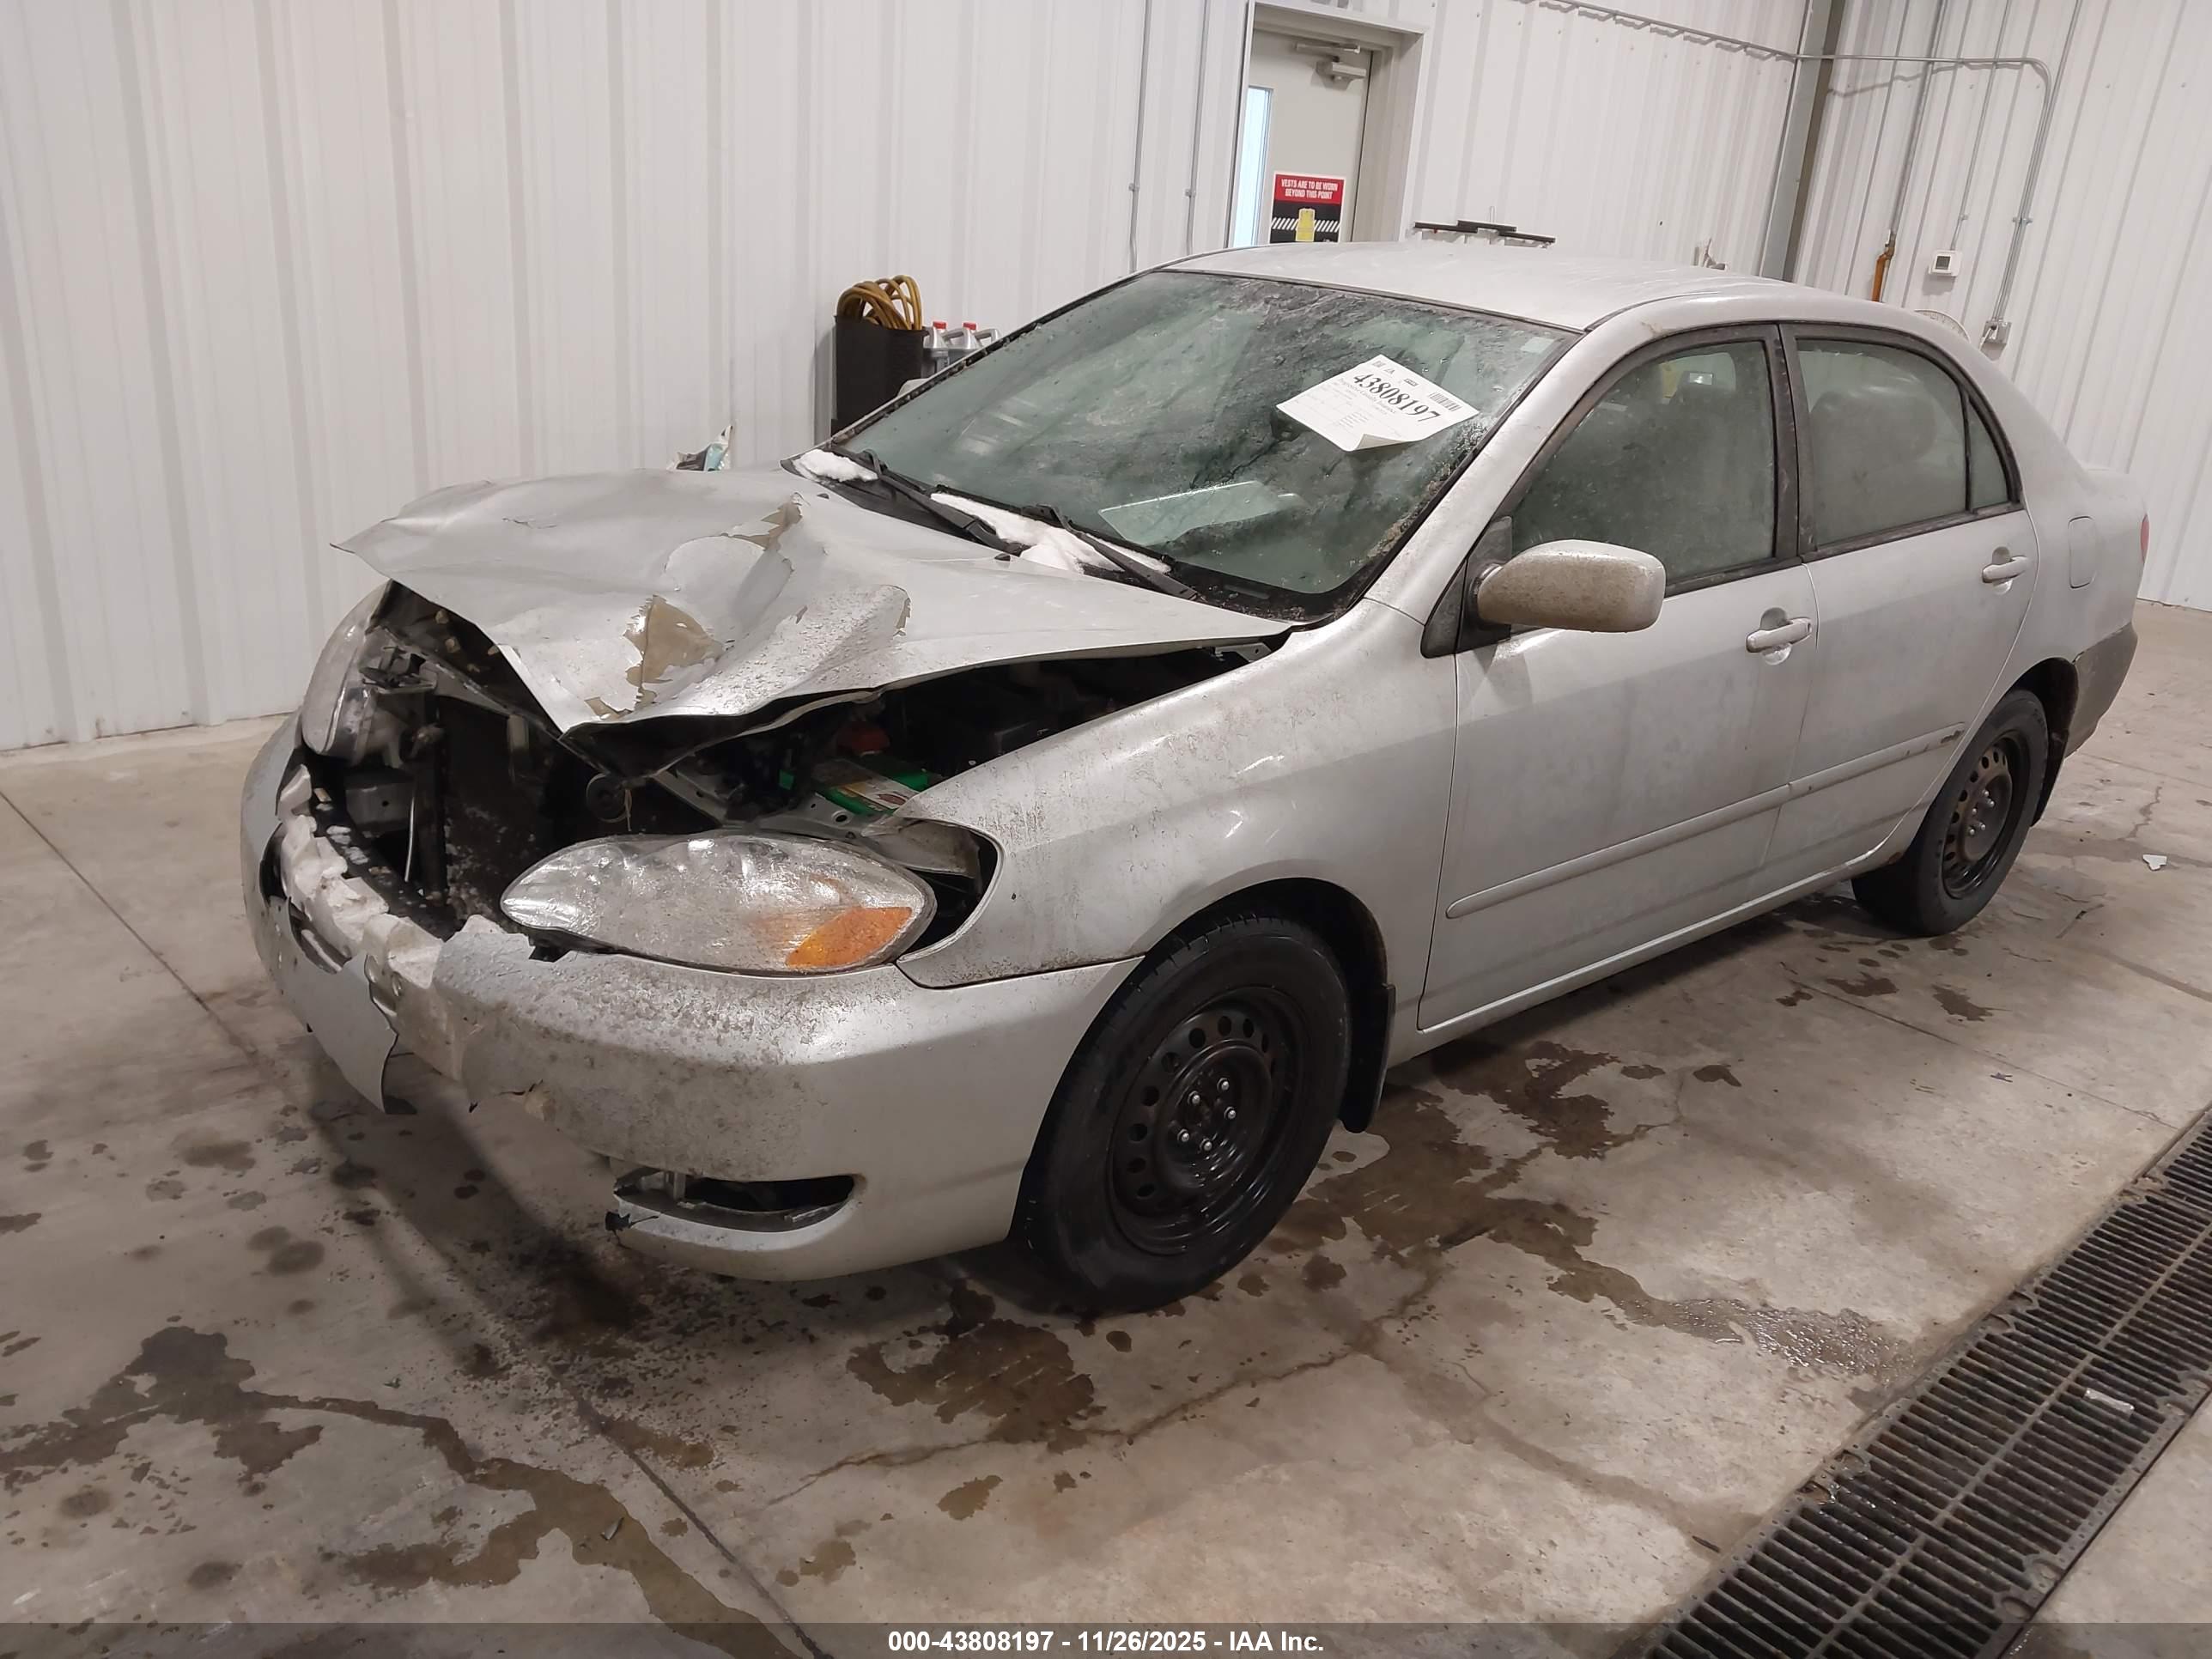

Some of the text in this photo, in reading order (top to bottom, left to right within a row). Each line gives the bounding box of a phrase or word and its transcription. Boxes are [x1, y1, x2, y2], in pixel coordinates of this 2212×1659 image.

[1281, 179, 1338, 191] VESTS ARE TO BE WORN
[1285, 188, 1333, 200] BEYOND THIS POINT
[1353, 374, 1440, 422] 43808197
